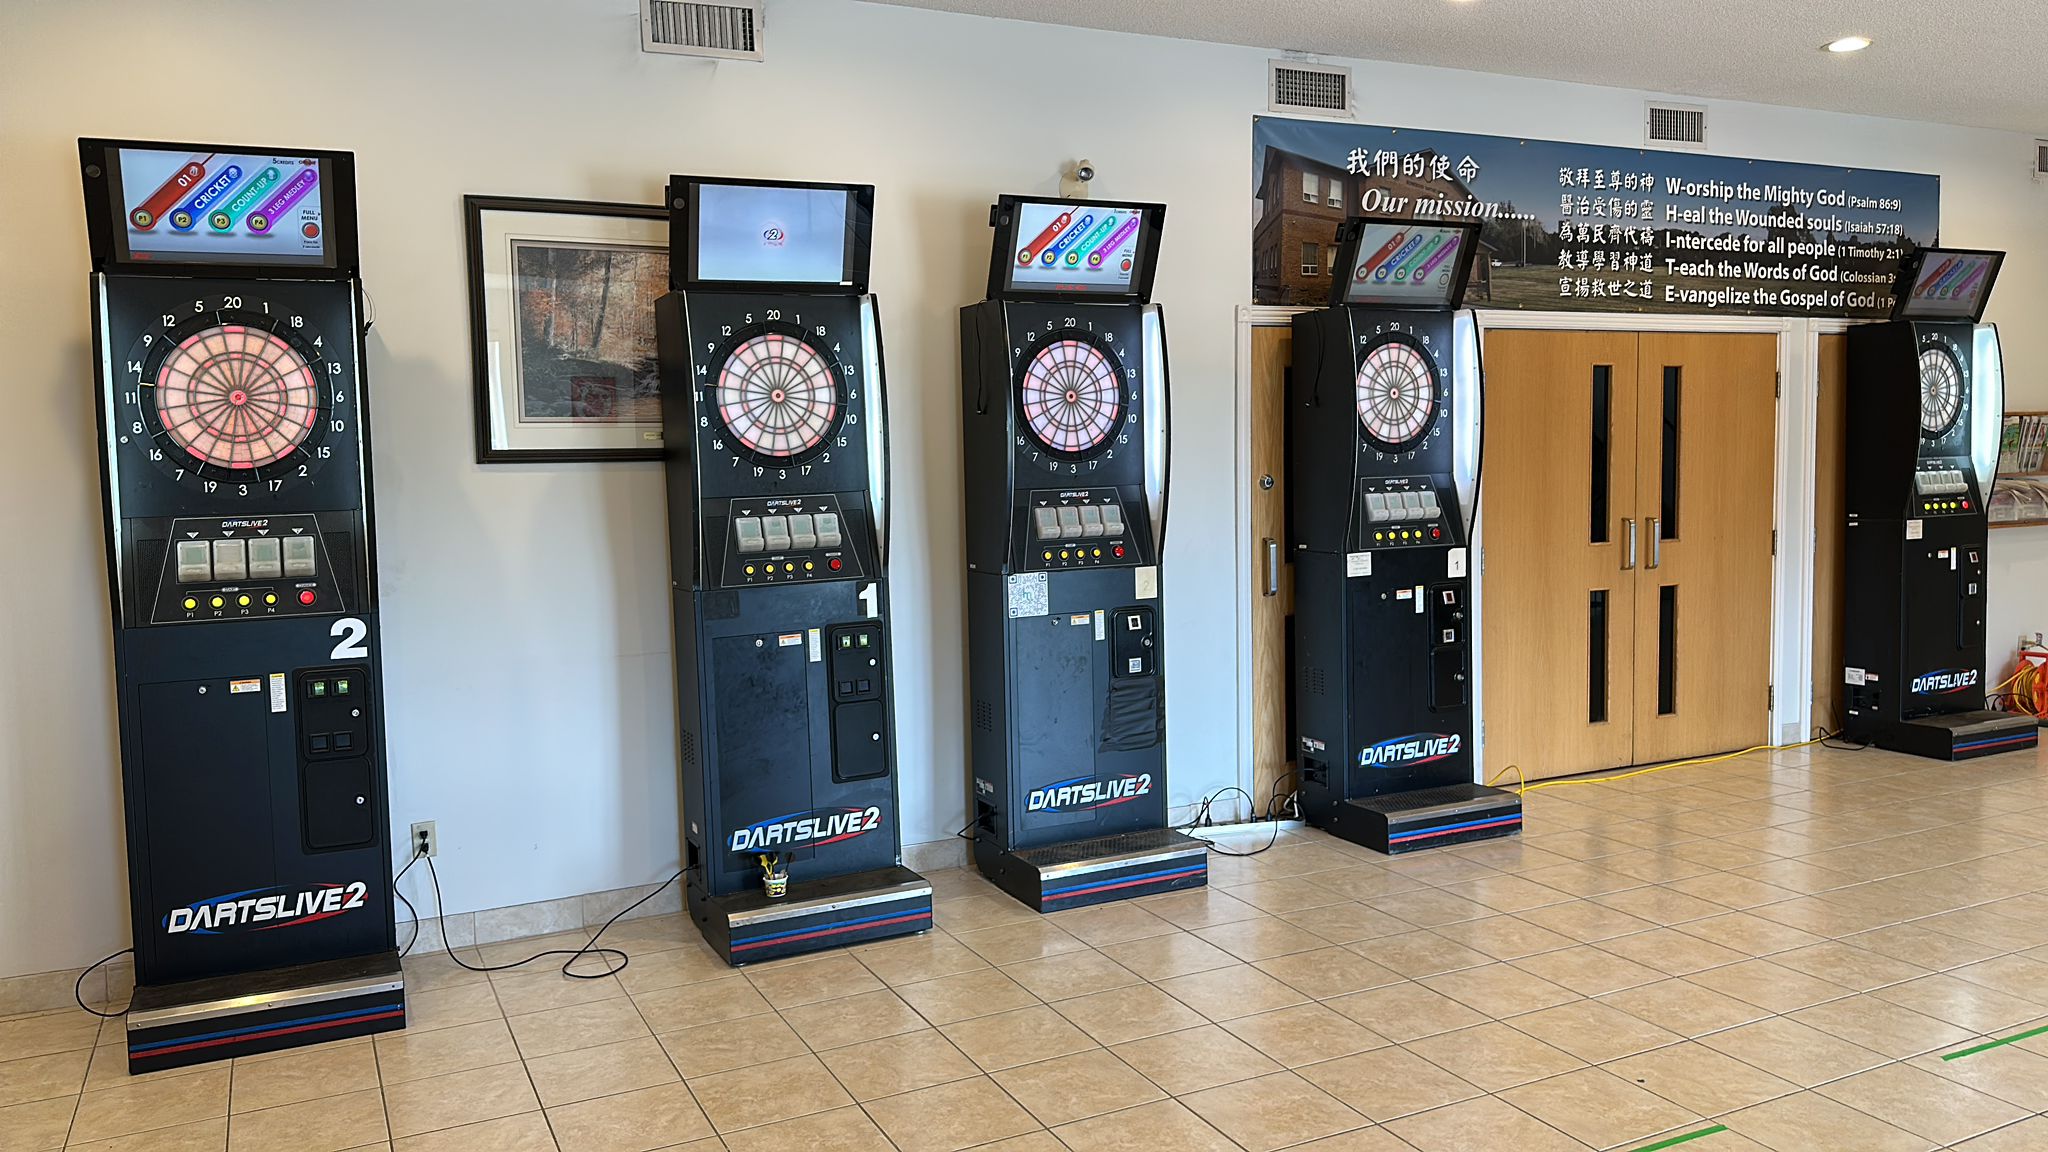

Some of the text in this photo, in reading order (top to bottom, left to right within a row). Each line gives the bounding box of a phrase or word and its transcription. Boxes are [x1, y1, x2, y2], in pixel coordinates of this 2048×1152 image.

[1346, 147, 1480, 183] 我們的使命
[177, 174, 192, 187] 01
[1559, 167, 1655, 192] 敬拜至尊的神
[194, 174, 232, 210] CRICKET
[231, 177, 268, 212] COUNT-UP
[268, 180, 306, 215] 3 LEG MEDLEY
[1666, 176, 1901, 212] W-orship the Mighty God (Psalm 86:9)
[1362, 188, 1408, 212] Our
[1560, 194, 1654, 220] 醫治受傷的靈
[254, 218, 264, 226] P4
[1666, 204, 1902, 236] H-eal the Wounded souls (Isaiah 57:18)
[1052, 222, 1062, 232] 01
[1059, 222, 1086, 249] CRICKET
[1666, 231, 1740, 252] I-ntercede
[1744, 234, 1764, 252] for
[1768, 236, 1784, 254] all
[1788, 240, 1836, 260] people
[1838, 246, 1846, 258] (1
[1848, 246, 1884, 261] Timothy
[1558, 248, 1654, 273] 教導學習神道
[1666, 258, 1714, 276] T-each
[1718, 260, 1741, 278] the
[1744, 262, 1790, 280] Words
[1792, 264, 1807, 280] of
[1810, 265, 1838, 282] God
[1840, 270, 1886, 283] (Colossian
[1558, 276, 1654, 299] 宣揚救世之道
[224, 296, 242, 309] 20
[1666, 286, 1884, 310] E-vangelize the Gospel of God (1
[195, 301, 203, 312] 5
[263, 302, 268, 314] 1
[745, 313, 752, 324] 5
[767, 309, 780, 320] 20
[162, 315, 175, 327] 12
[290, 316, 303, 328] 18
[1047, 321, 1053, 330] 5
[1064, 317, 1076, 327] 20
[1390, 322, 1400, 331] 20
[722, 326, 731, 336] 12
[816, 326, 826, 336] 18
[1376, 325, 1381, 334] 5
[143, 335, 152, 347] 9
[314, 336, 323, 347] 4
[1027, 332, 1035, 341] 12
[1105, 332, 1113, 342] 18
[1360, 335, 1367, 344] 12
[1422, 335, 1430, 345] 18
[708, 343, 715, 353] 9
[834, 342, 840, 352] 4
[1015, 348, 1021, 357] 9
[1119, 348, 1125, 357] 4
[1434, 349, 1439, 358] 4
[128, 361, 142, 373] 14
[328, 362, 341, 374] 13
[696, 365, 707, 375] 14
[844, 365, 854, 375] 13
[1440, 368, 1448, 377] 13
[1127, 369, 1136, 378] 13
[125, 392, 137, 404] 11
[336, 391, 344, 402] 6
[694, 391, 704, 402] 11
[850, 389, 857, 399] 6
[1131, 391, 1137, 400] 6
[1443, 388, 1448, 397] 6
[846, 414, 857, 424] 10
[1128, 414, 1137, 423] 10
[1440, 409, 1448, 418] 10
[331, 420, 344, 432] 10
[700, 416, 708, 427] 8
[133, 422, 142, 434] 8
[713, 439, 723, 450] 16
[837, 437, 847, 447] 15
[1017, 436, 1025, 445] 16
[1119, 434, 1128, 444] 15
[1363, 443, 1367, 452] 7
[1423, 441, 1428, 450] 2
[149, 449, 162, 461] 16
[317, 447, 330, 458] 15
[823, 453, 830, 463] 2
[1033, 452, 1038, 462] 7
[1107, 449, 1113, 459] 2
[1376, 452, 1383, 461] 19
[1408, 451, 1415, 460] 17
[732, 457, 739, 467] 7
[1393, 454, 1398, 463] 3
[801, 465, 811, 475] 17
[1049, 461, 1058, 471] 19
[1070, 464, 1076, 474] 3
[1089, 460, 1098, 470] 17
[175, 469, 184, 481] 7
[298, 465, 307, 477] 2
[753, 467, 764, 477] 19
[779, 469, 786, 479] 3
[204, 481, 217, 493] 19
[239, 484, 248, 496] 3
[269, 480, 282, 491] 17
[222, 520, 268, 528] DARTSLIVE2
[1143, 580, 1150, 591] 2
[858, 582, 878, 618] 1
[330, 618, 368, 659] 2
[1911, 670, 1977, 693] DARTSLIVE2
[1361, 734, 1460, 765] DARTSLIVE2
[1028, 774, 1151, 810] DARTSLIVE2
[732, 806, 880, 851] DARTSLIVE2
[168, 882, 367, 933] DARTSLIVE2
